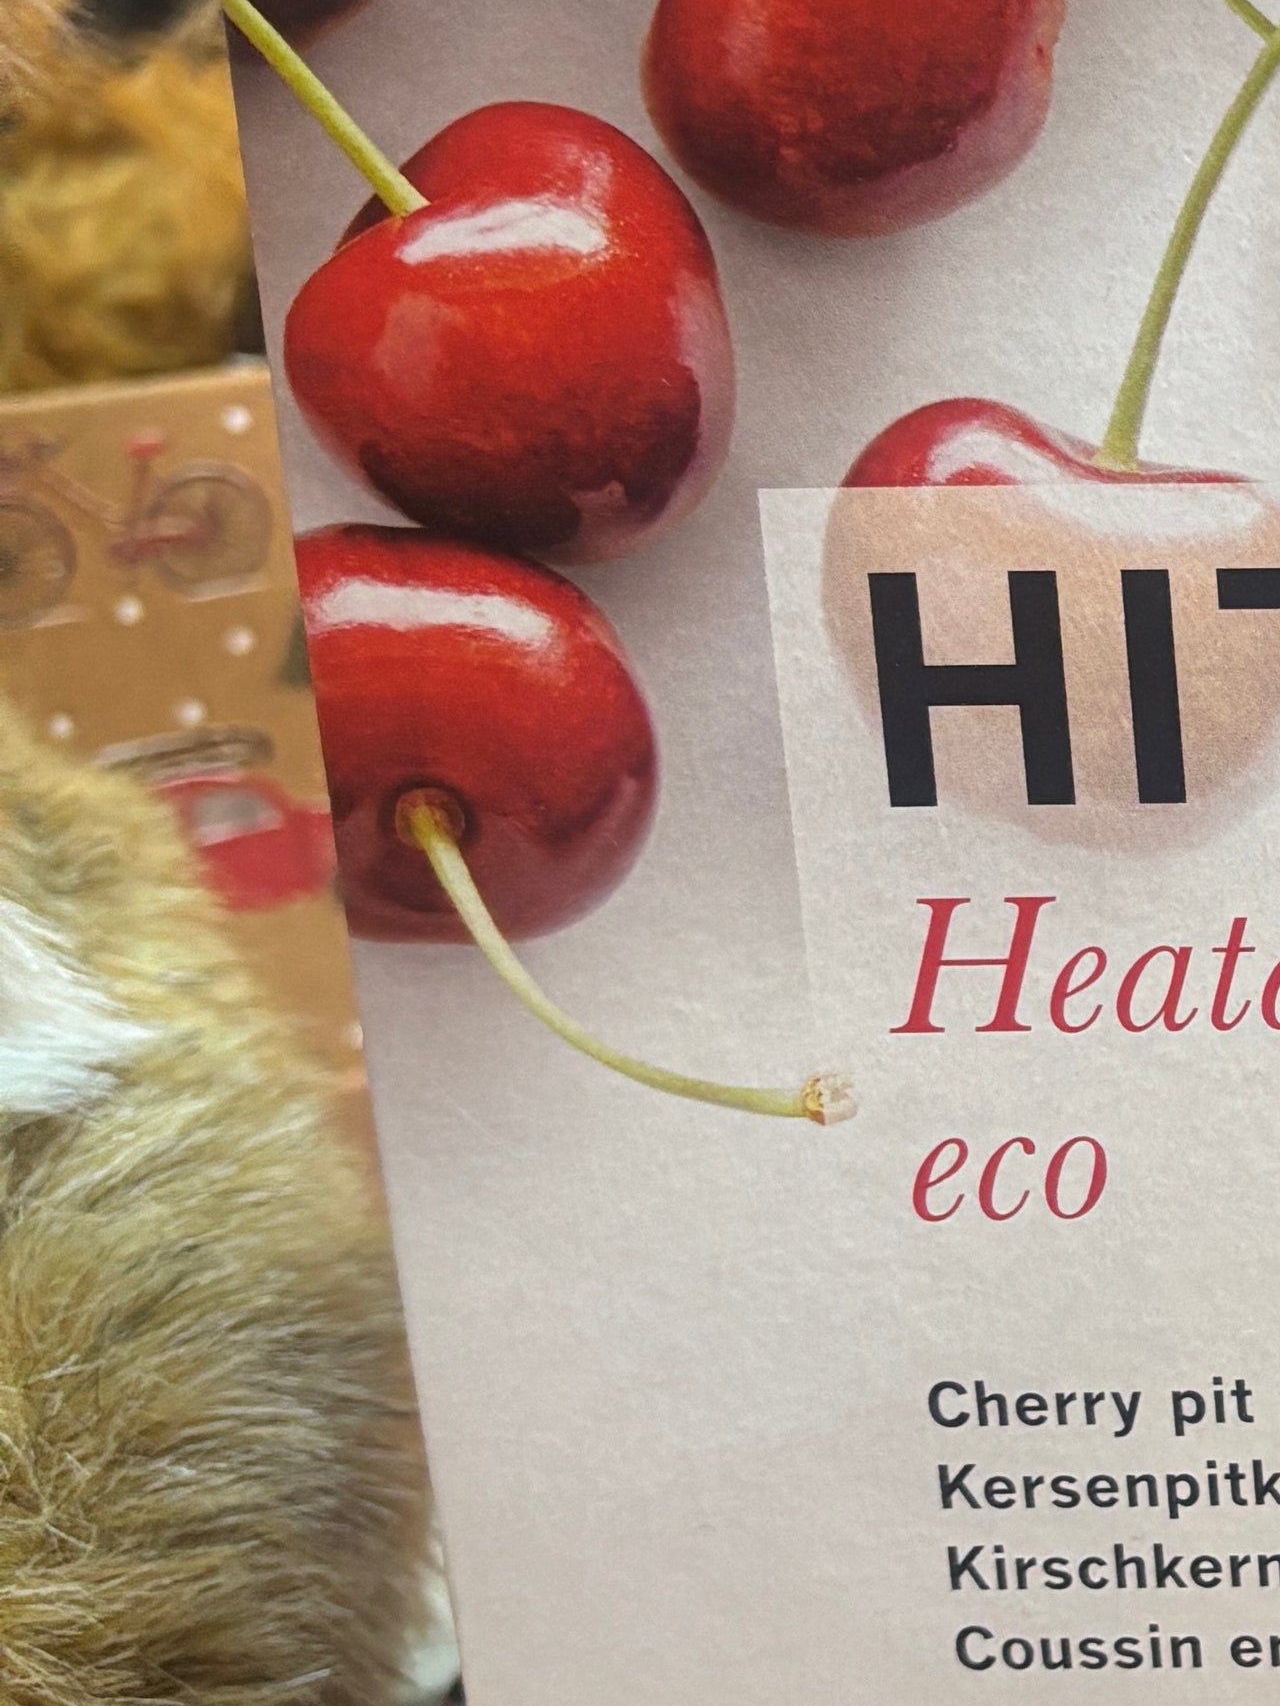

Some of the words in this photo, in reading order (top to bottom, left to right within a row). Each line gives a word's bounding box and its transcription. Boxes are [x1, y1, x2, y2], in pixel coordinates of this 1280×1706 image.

[911, 1136, 1109, 1223] eco
[927, 1379, 1142, 1439] Cherry
[1171, 1376, 1255, 1437] pit
[954, 1625, 1203, 1672] Coussin
